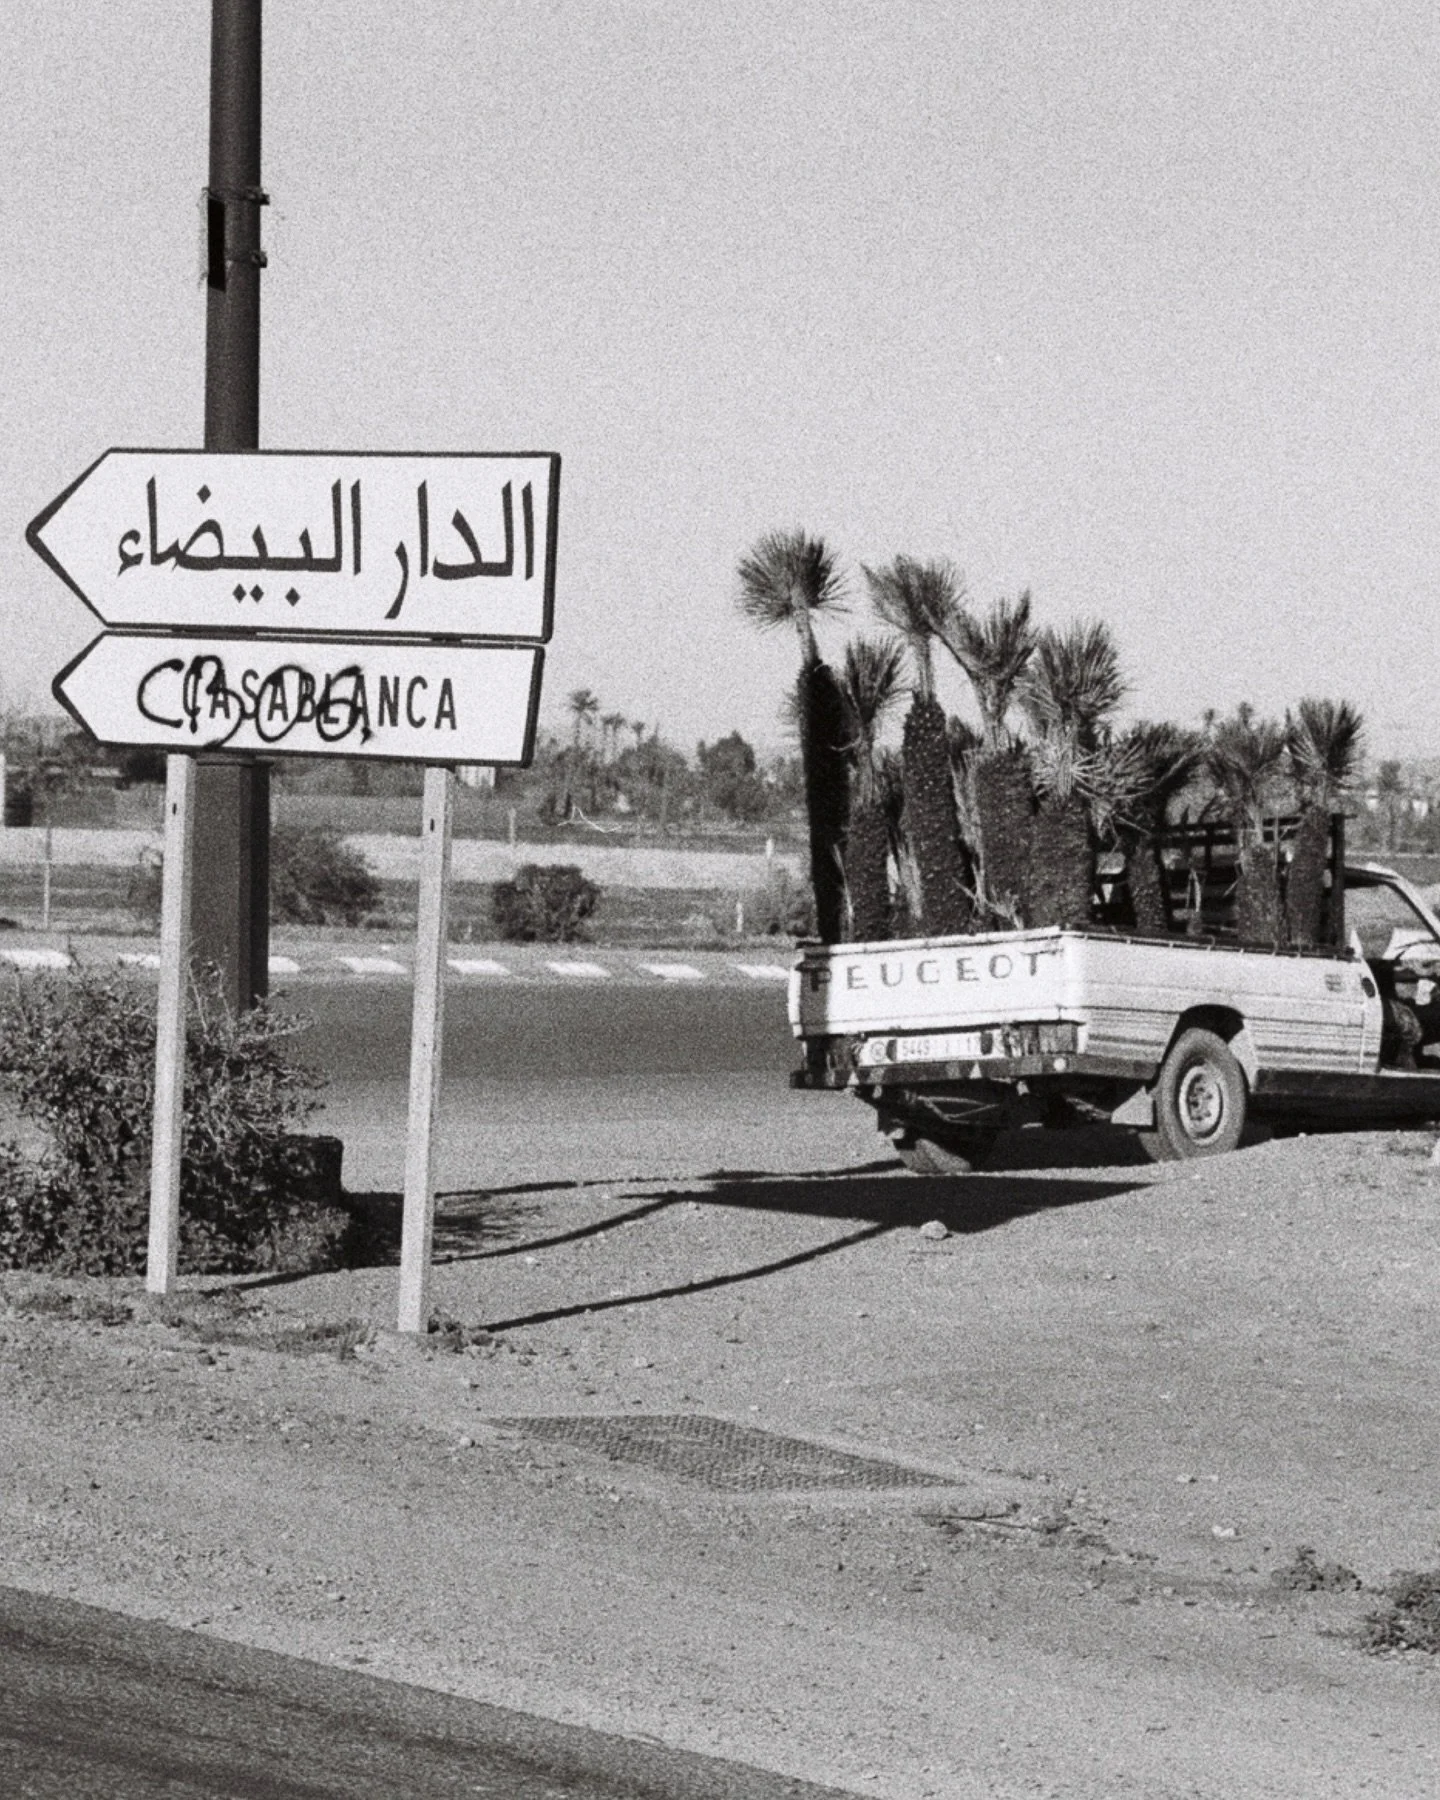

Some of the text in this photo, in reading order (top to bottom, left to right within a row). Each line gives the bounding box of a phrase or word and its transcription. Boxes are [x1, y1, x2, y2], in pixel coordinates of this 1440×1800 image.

[116, 475, 533, 620] الدار البيضاء
[182, 664, 458, 731] CASABLANCA
[808, 951, 1044, 992] PEUGEOT
